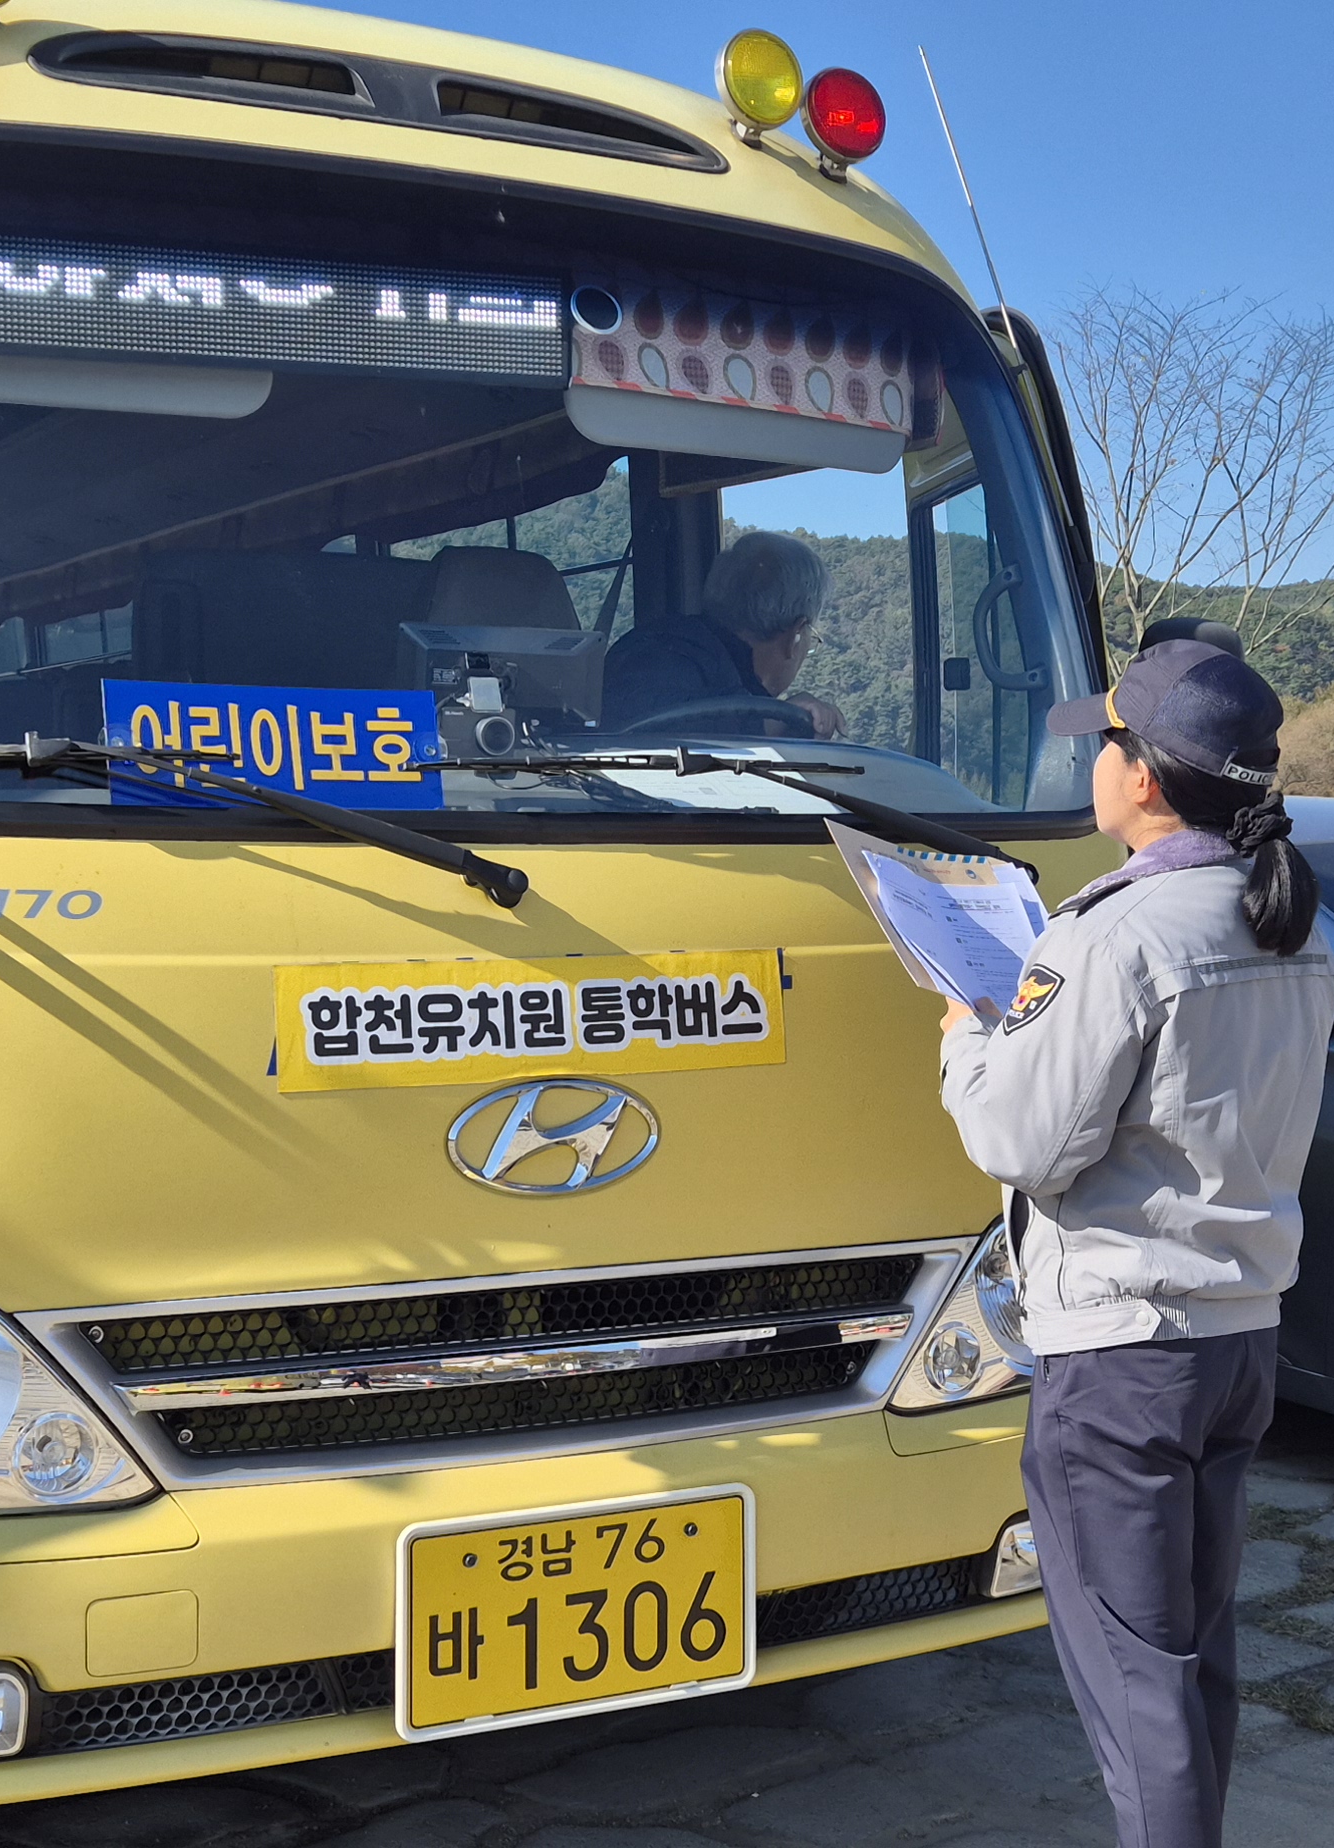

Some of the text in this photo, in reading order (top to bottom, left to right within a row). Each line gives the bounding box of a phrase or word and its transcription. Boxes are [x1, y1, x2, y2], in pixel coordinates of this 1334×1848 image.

[130, 700, 422, 790] 어린이보호
[307, 979, 764, 1058] 합천유치원 통학버스
[498, 1517, 666, 1582] 경남 76
